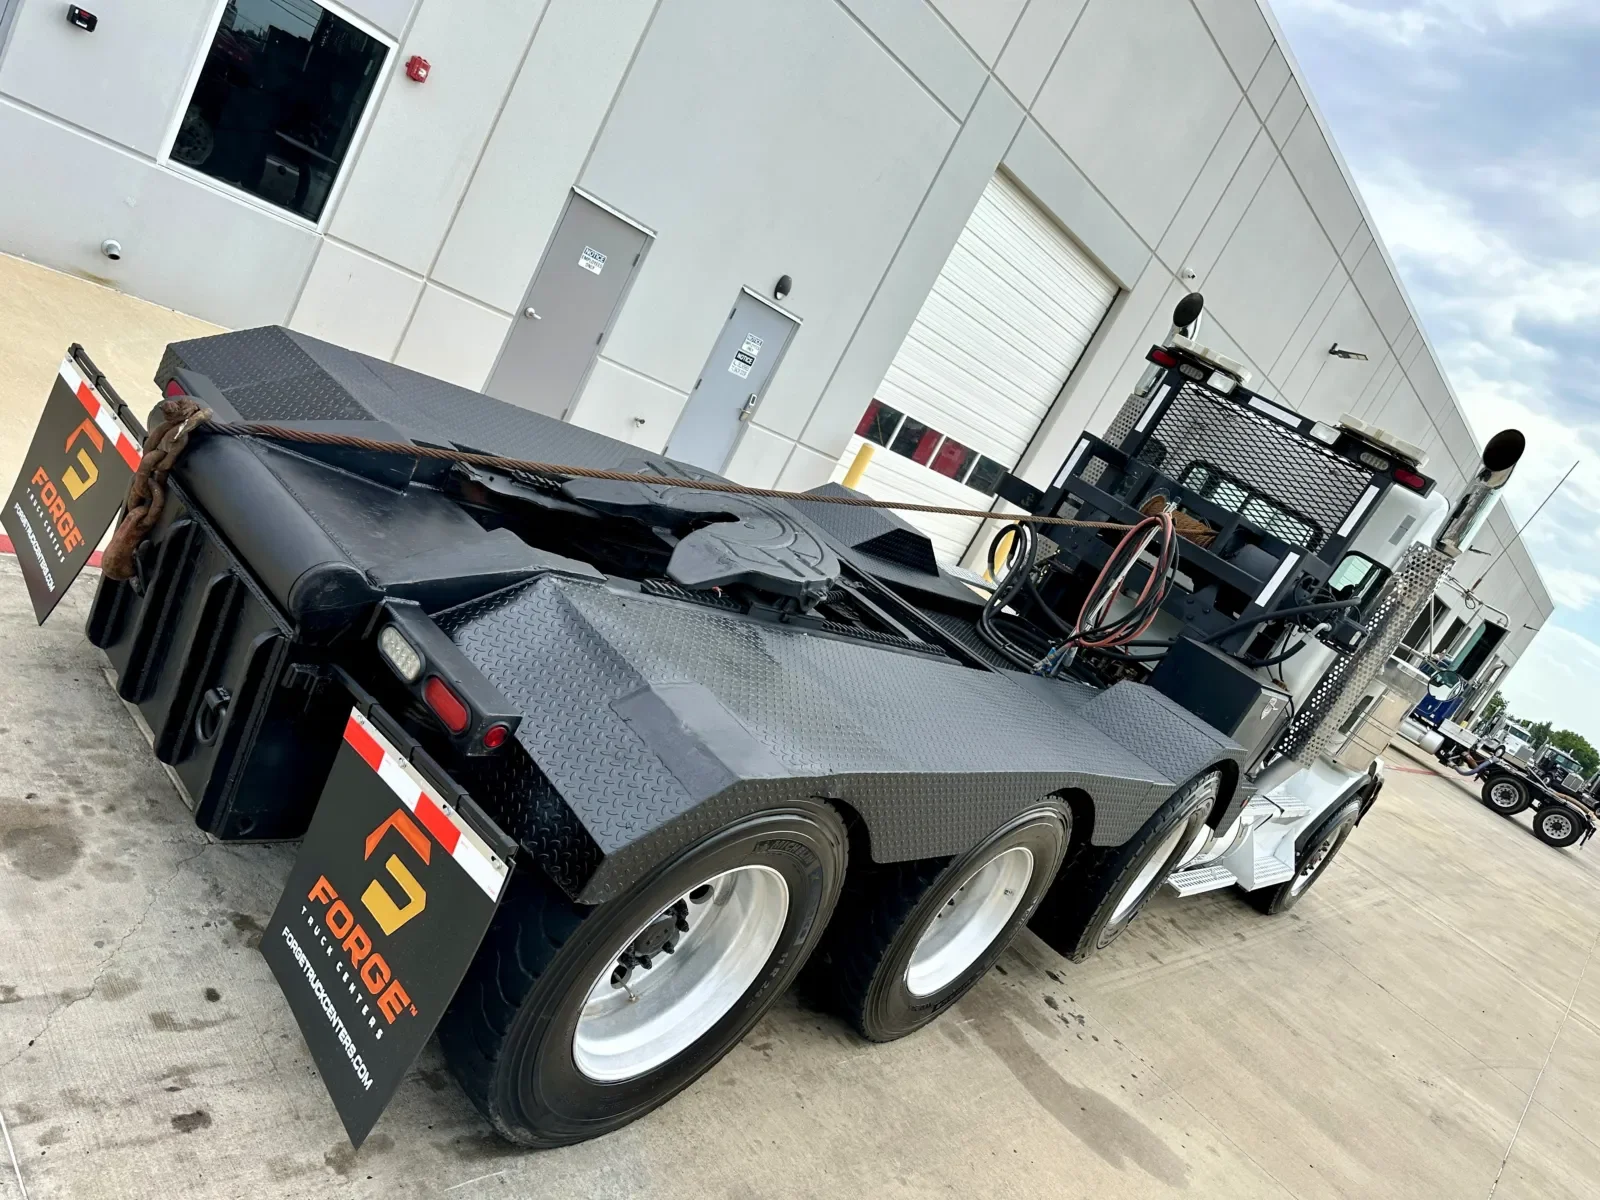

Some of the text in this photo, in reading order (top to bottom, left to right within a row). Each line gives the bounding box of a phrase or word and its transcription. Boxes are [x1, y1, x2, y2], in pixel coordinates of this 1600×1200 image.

[584, 247, 605, 263] NOTICE
[736, 352, 753, 364] NOTICE
[13, 502, 56, 593] FORGETRUCKCENTERS.COM
[26, 487, 65, 563] TRUCK CENTERS
[31, 466, 81, 553] FORGE
[772, 840, 817, 867] MICHELIN
[301, 906, 384, 1041] TRUCK CENTERS
[308, 875, 411, 1025] FORGE
[281, 926, 374, 1091] FORGETRUCKCENTERS.COM
